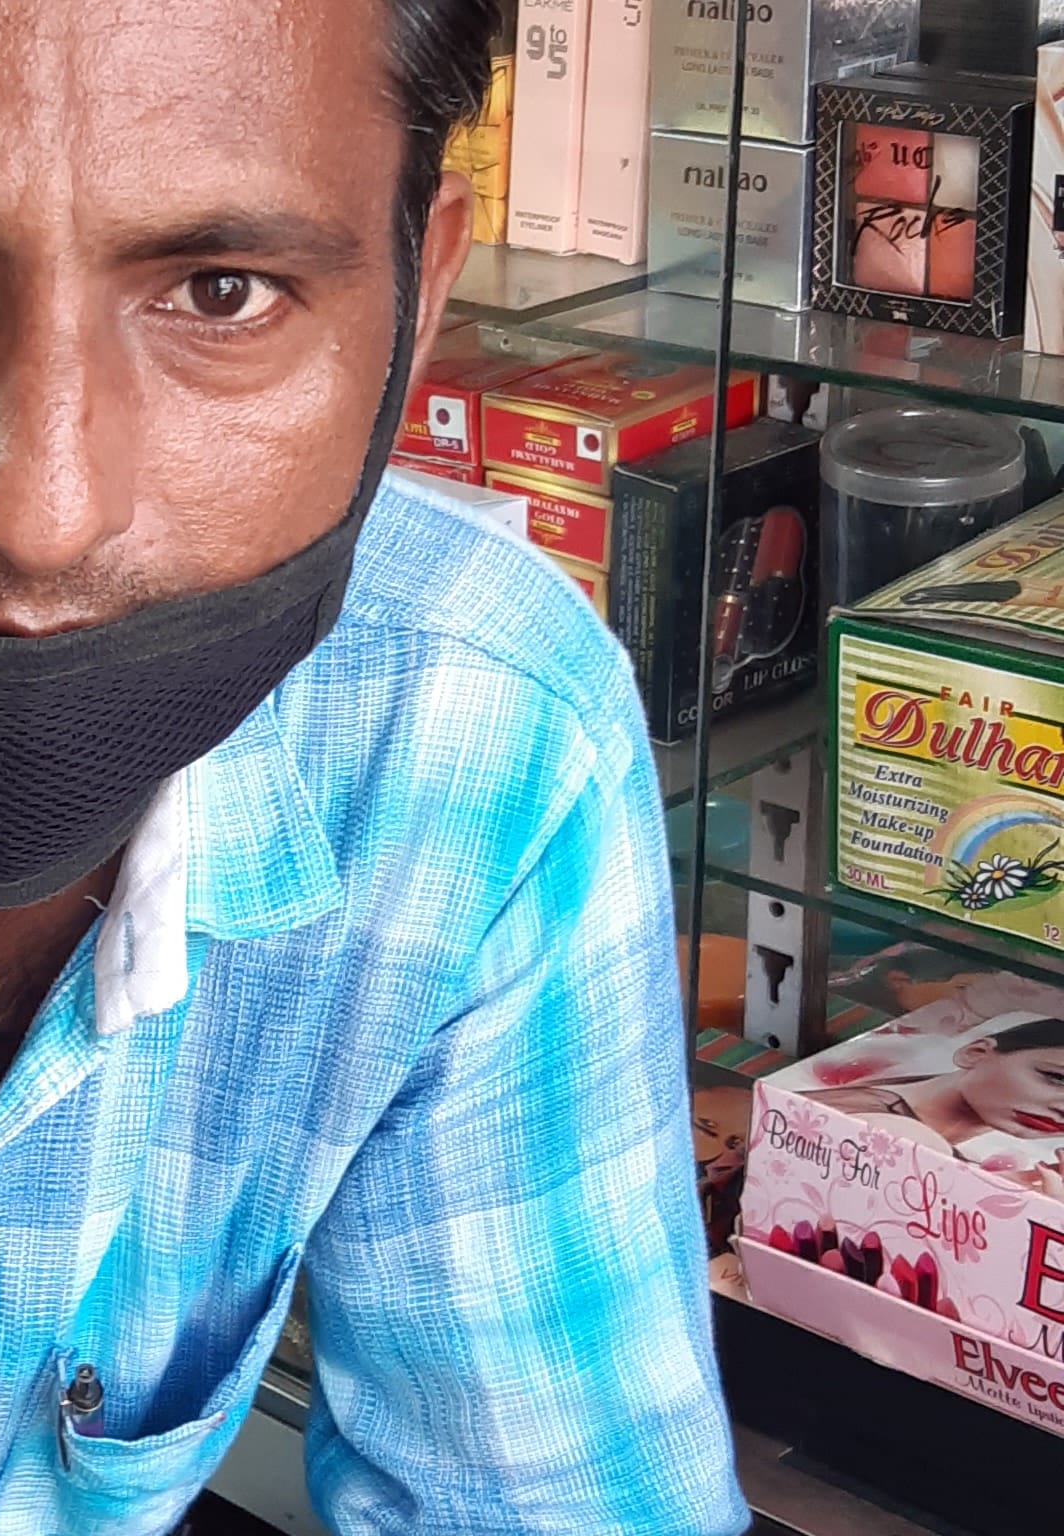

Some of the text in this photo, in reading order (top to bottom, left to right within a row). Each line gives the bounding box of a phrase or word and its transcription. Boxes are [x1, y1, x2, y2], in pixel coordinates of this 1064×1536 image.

[534, 510, 565, 527] GOLD
[677, 669, 768, 726] COOR LIP
[939, 685, 1015, 718] FAIR
[874, 764, 924, 789] Extra
[847, 780, 950, 824] Moisturizing
[859, 809, 935, 841] Make-up
[850, 830, 944, 868] Foundation
[845, 865, 863, 883] 30
[1043, 924, 1061, 942] 12
[763, 1109, 881, 1191] Beauty For
[901, 1170, 989, 1263] Lips
[957, 1373, 1022, 1409] Matte
